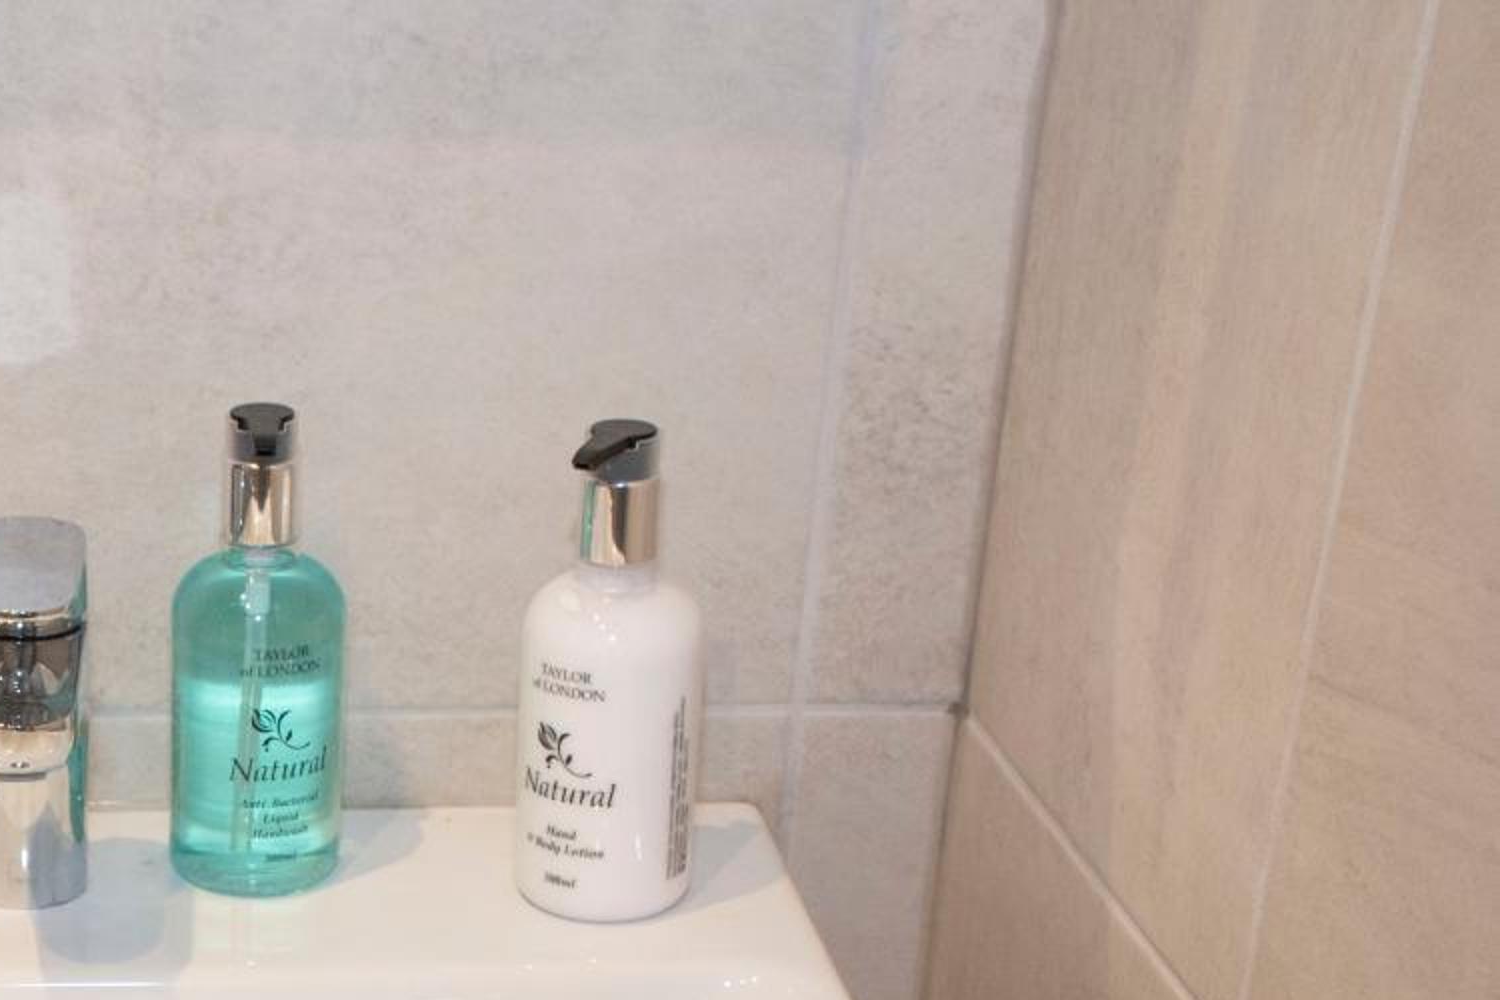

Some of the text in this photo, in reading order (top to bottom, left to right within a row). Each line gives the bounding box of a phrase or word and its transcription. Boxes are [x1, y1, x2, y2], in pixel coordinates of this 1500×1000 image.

[254, 644, 309, 661] TAYLOR
[240, 656, 322, 679] of LONDON
[541, 662, 593, 684] TAYLOR
[543, 678, 606, 702] LONDON
[229, 745, 327, 783] Natural
[524, 764, 617, 809] Natural
[263, 811, 299, 825] Liquid
[253, 824, 309, 839] Handwash
[546, 822, 577, 841] Hand
[535, 835, 561, 856] Body
[564, 843, 605, 860] Lotion
